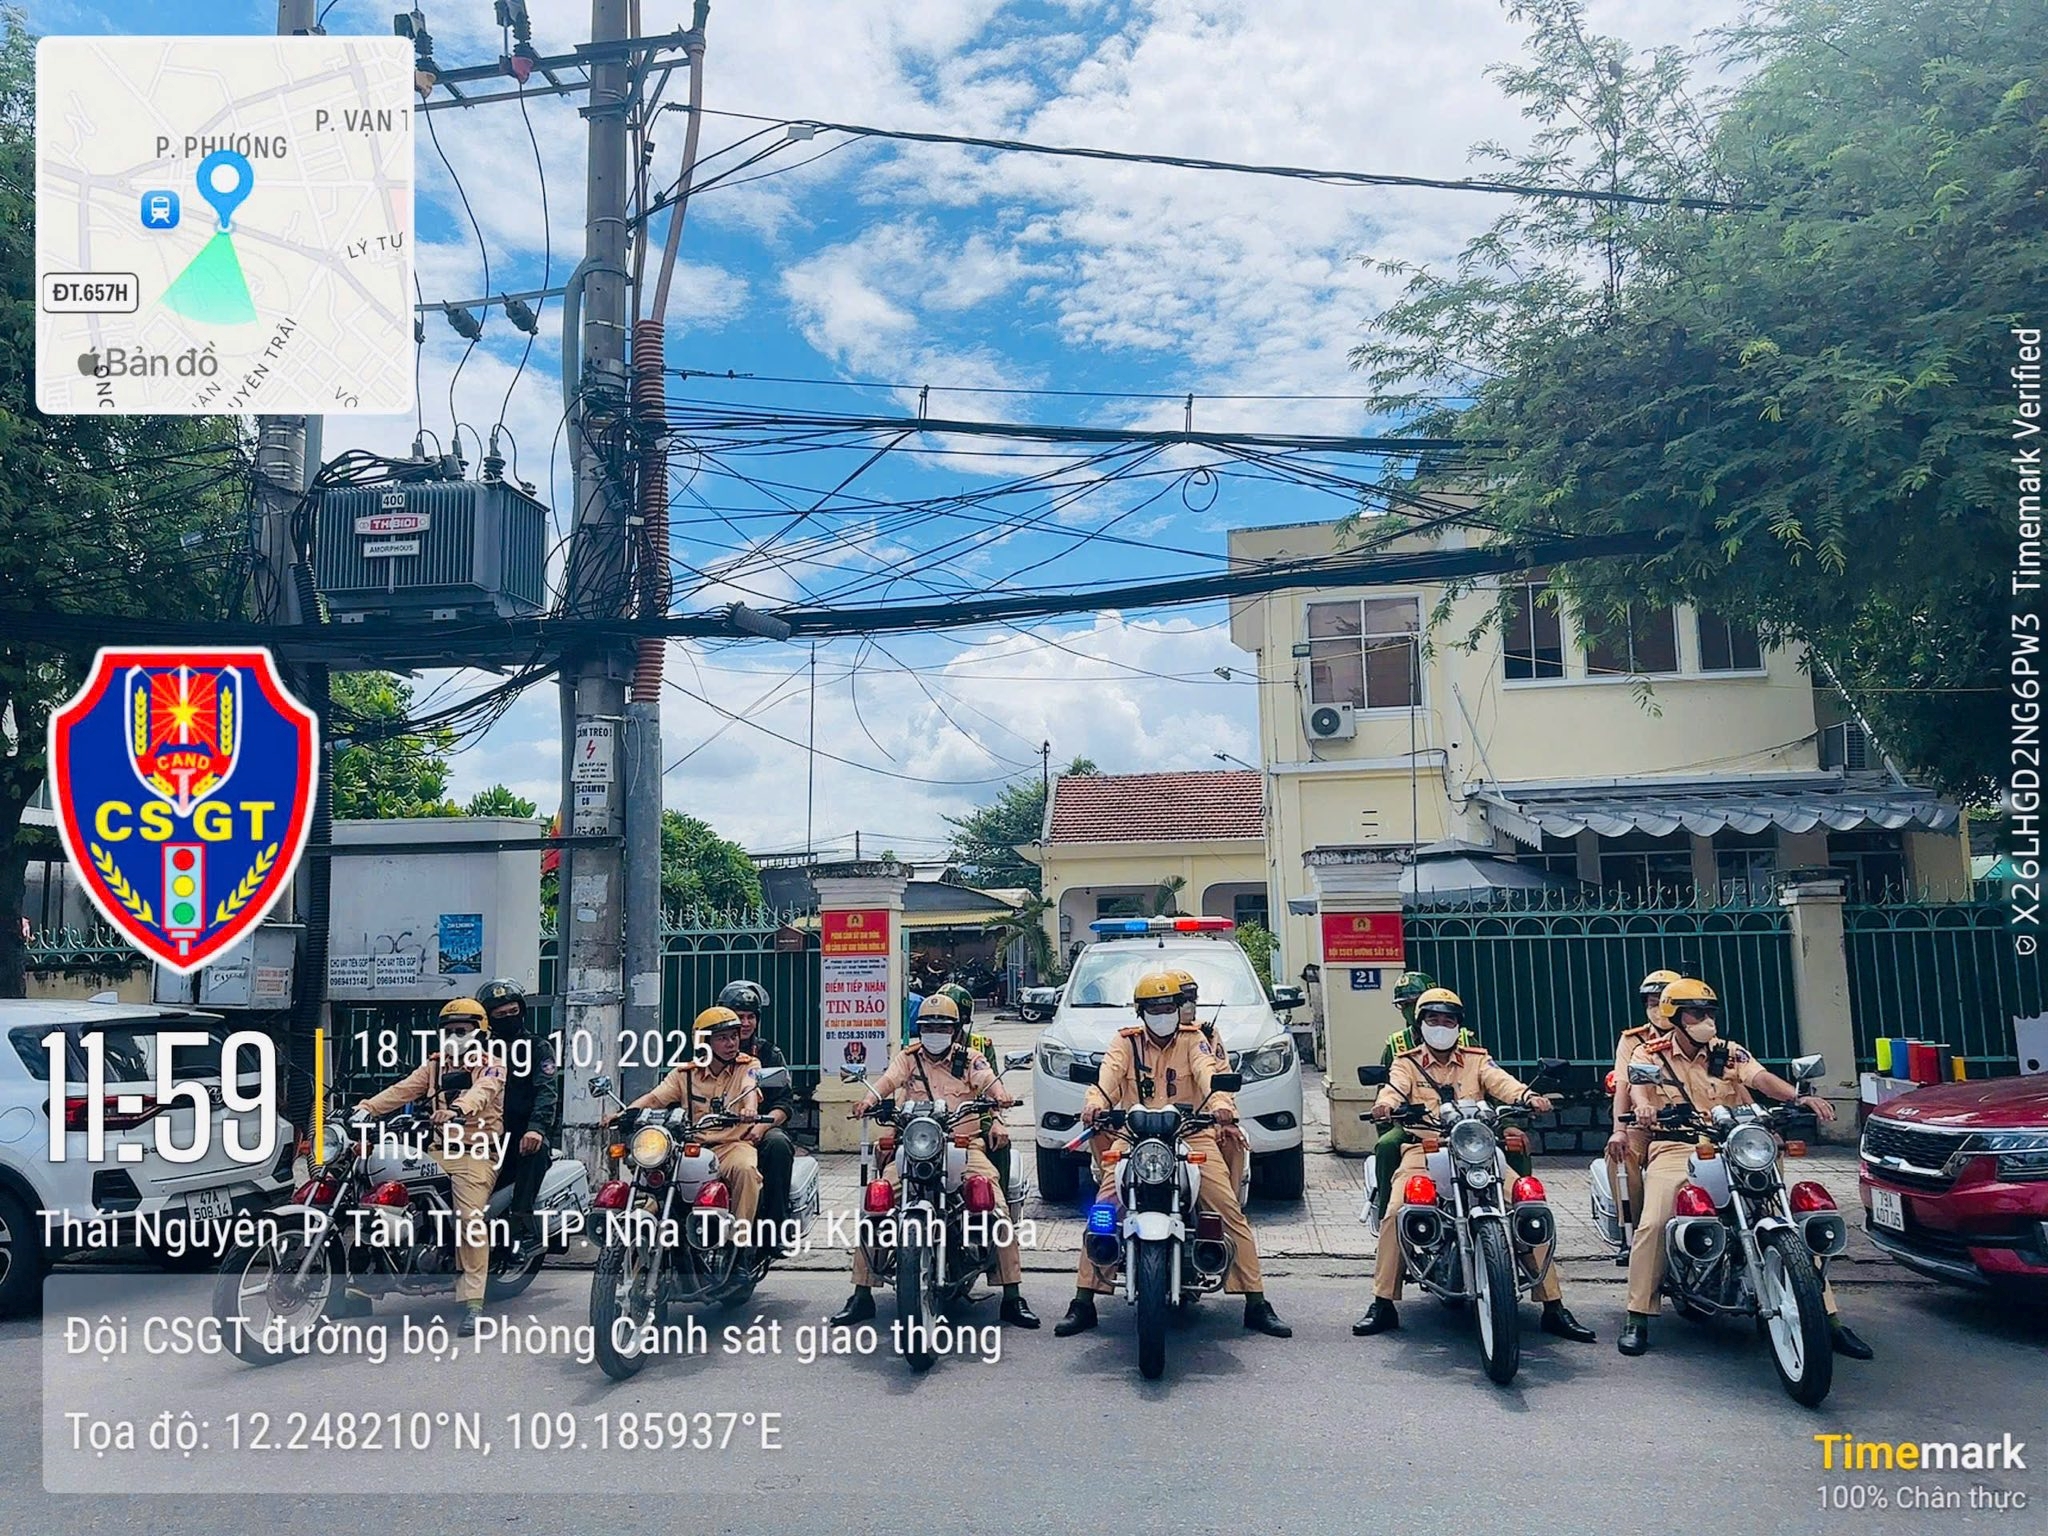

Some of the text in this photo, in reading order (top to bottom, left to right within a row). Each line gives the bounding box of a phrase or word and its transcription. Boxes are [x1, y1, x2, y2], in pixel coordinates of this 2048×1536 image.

[383, 494, 404, 506] 400
[1356, 970, 1375, 984] 21
[826, 995, 885, 1014] TIN BÁO
[200, 1190, 219, 1205] 47A
[193, 1203, 229, 1220] 508.14
